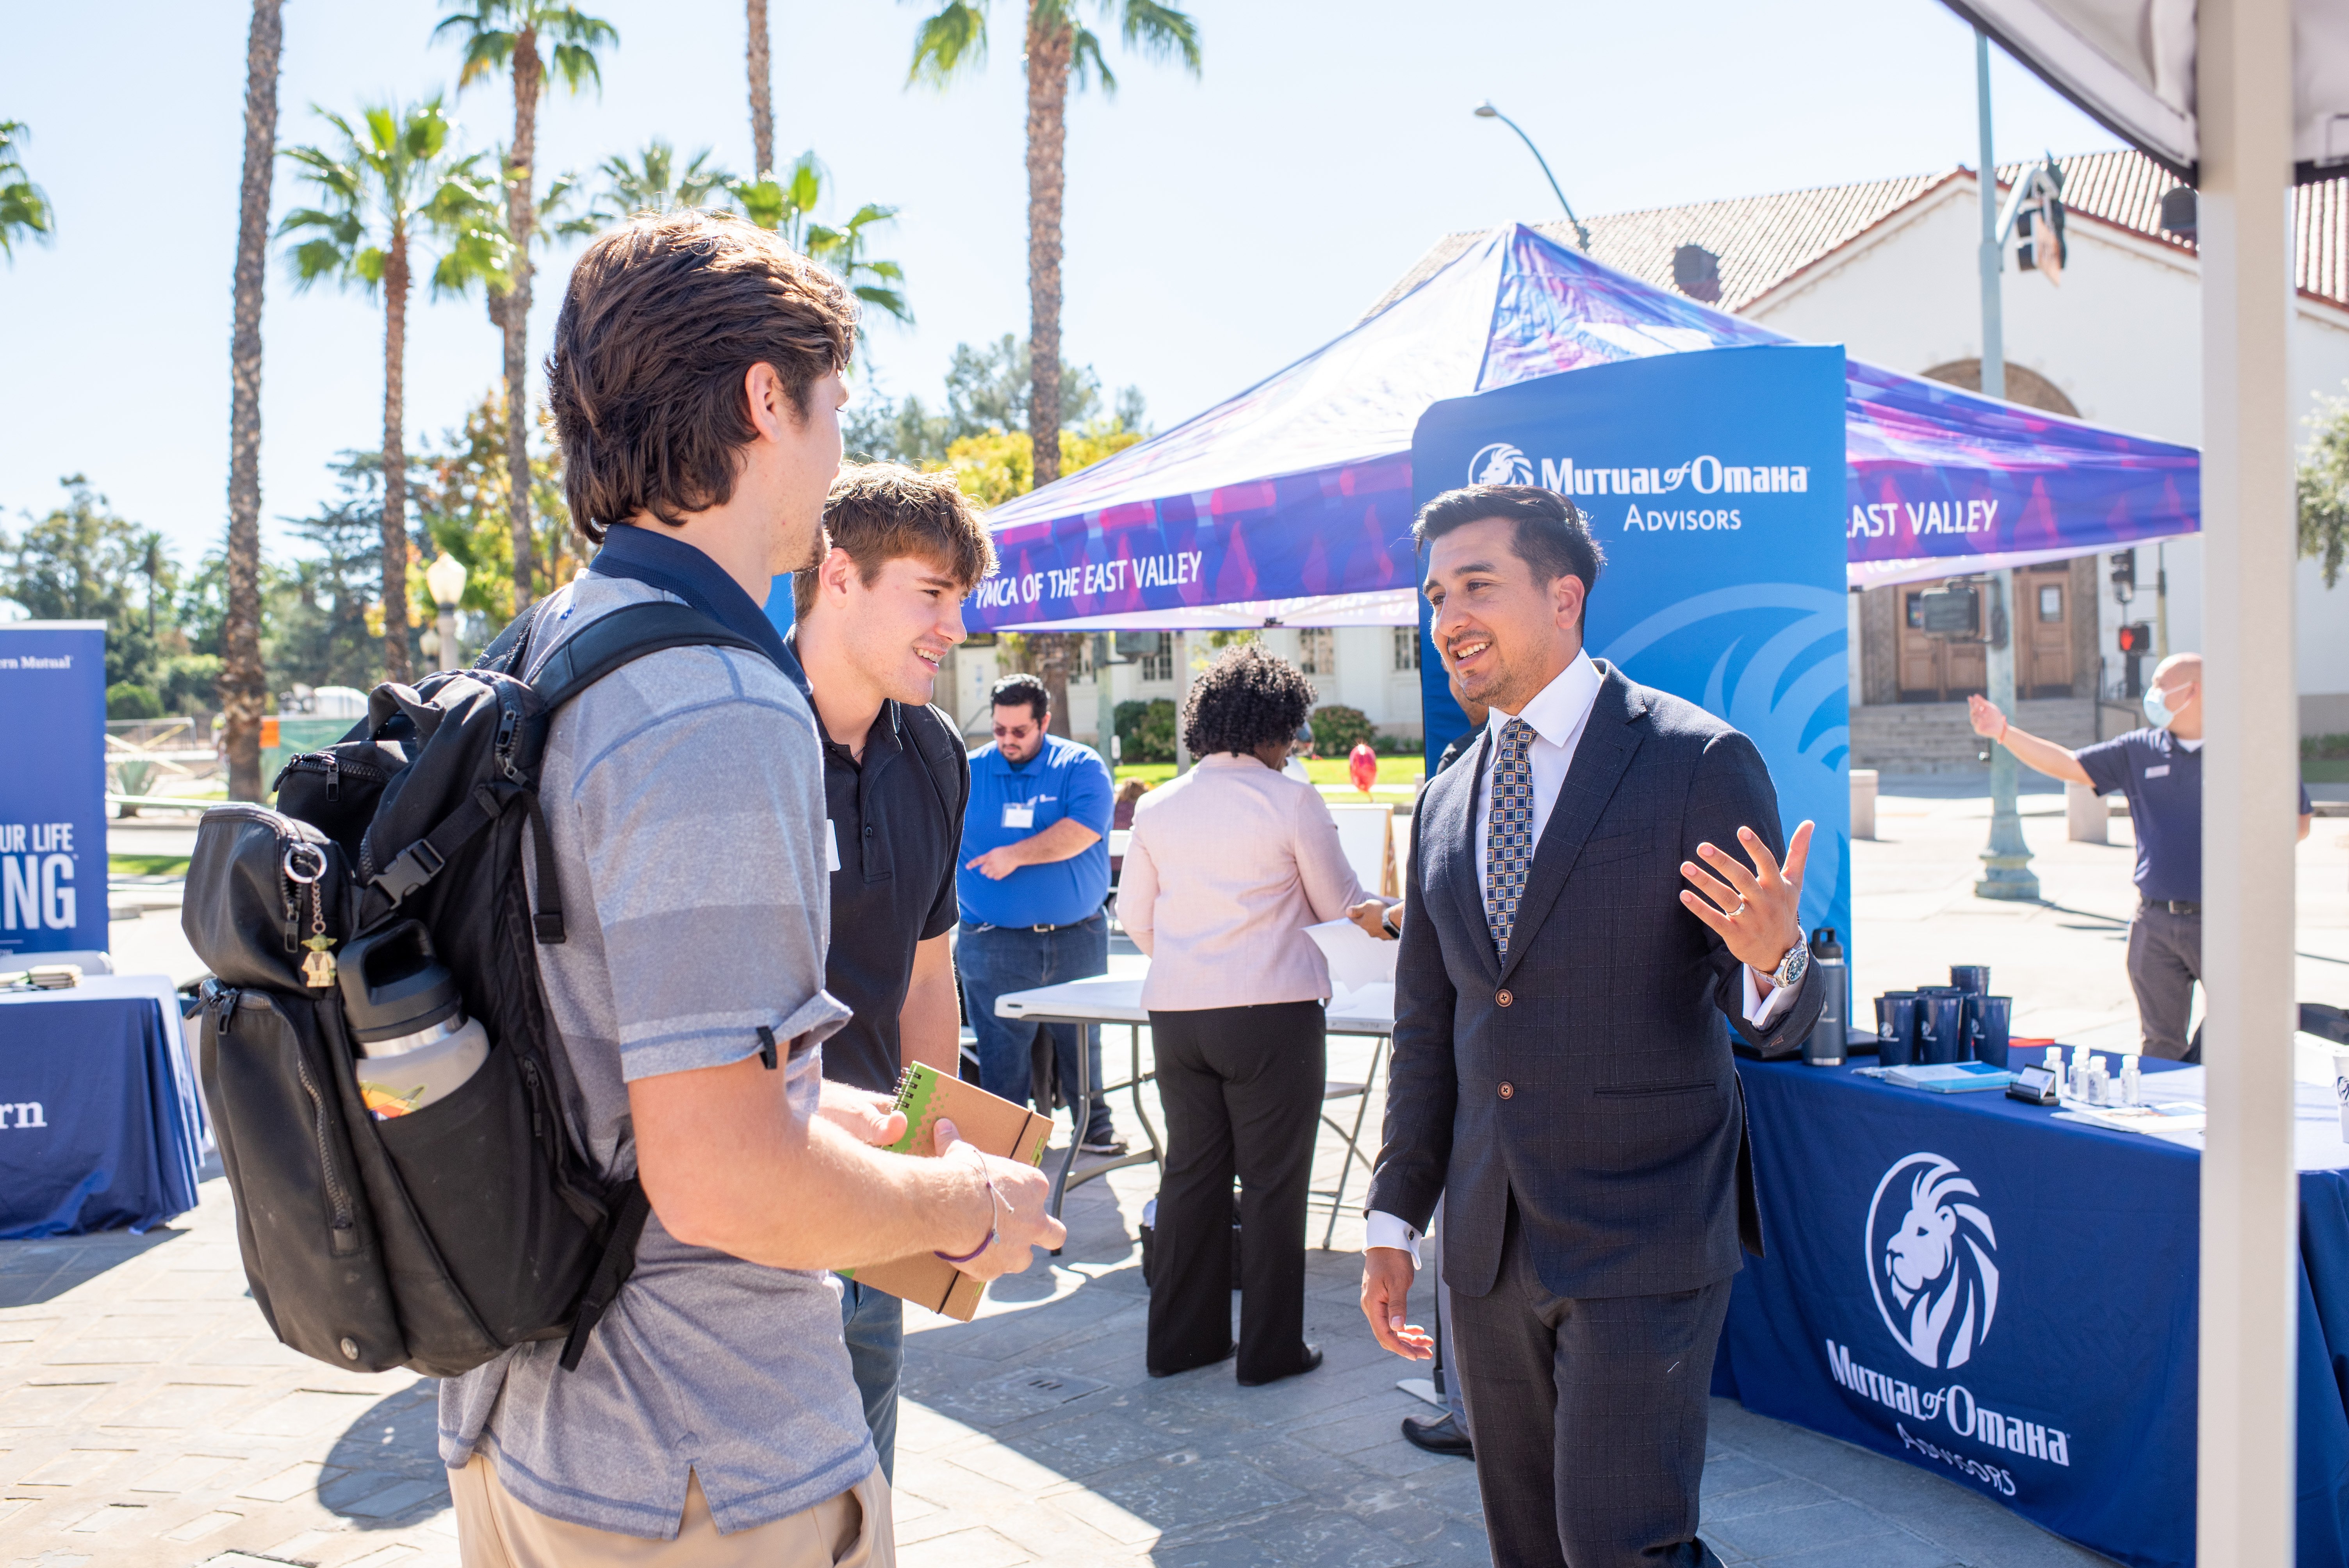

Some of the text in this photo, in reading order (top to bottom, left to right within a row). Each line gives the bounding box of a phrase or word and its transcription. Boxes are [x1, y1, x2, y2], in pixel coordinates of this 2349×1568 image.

[1663, 461, 1691, 491] of
[1905, 499, 1998, 536] VALLEY
[1021, 572, 1044, 603] OF
[1047, 567, 1081, 599] THE
[1083, 559, 1128, 595] EAST
[1132, 550, 1202, 589] VALLEY
[20, 655, 71, 669] Mutual
[32, 822, 75, 852] LIFE
[1922, 1387, 1946, 1420] of
